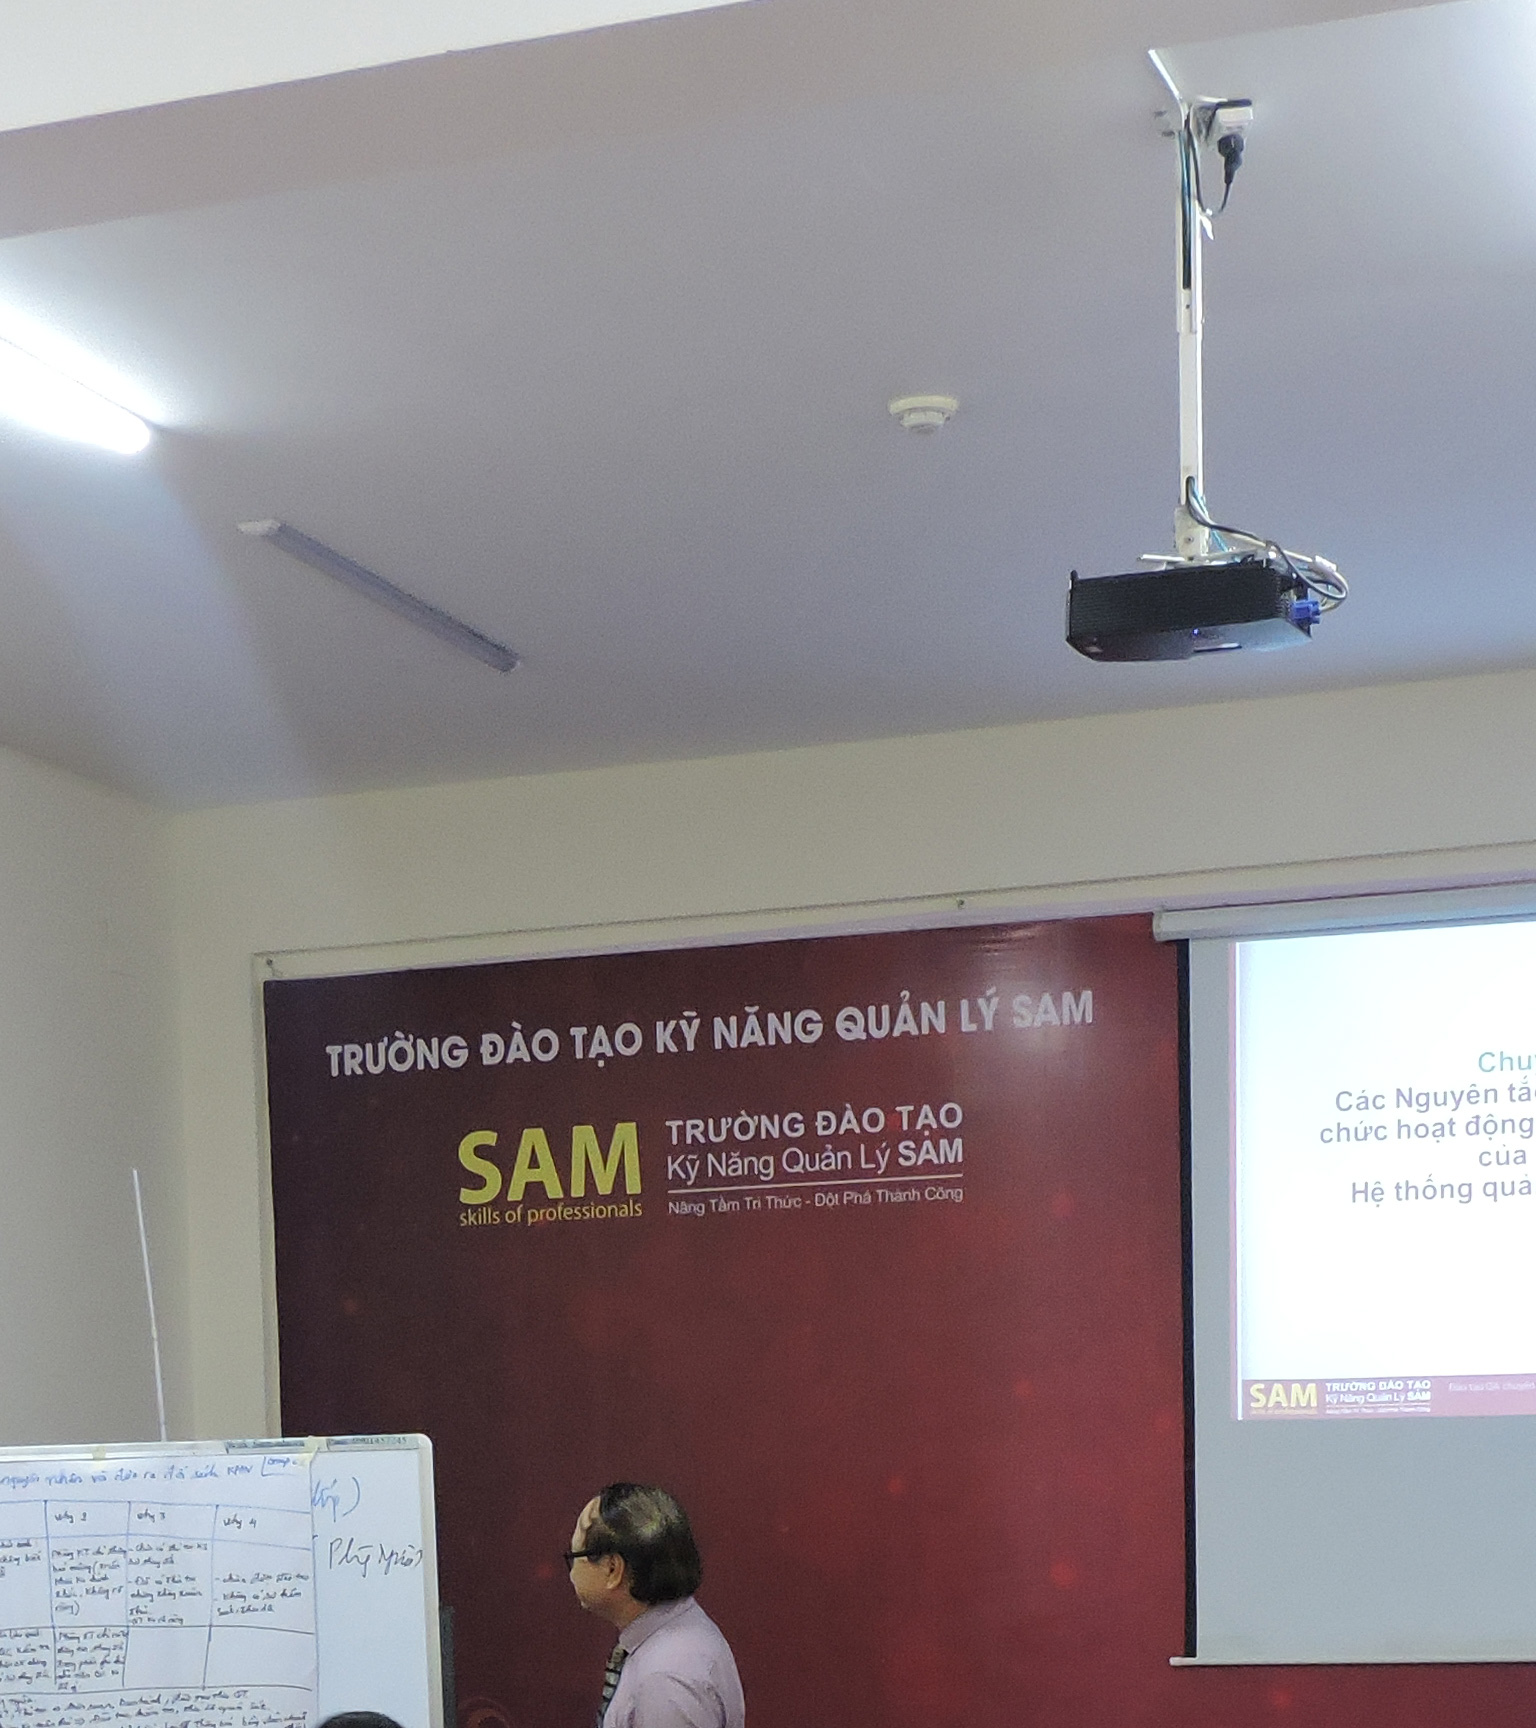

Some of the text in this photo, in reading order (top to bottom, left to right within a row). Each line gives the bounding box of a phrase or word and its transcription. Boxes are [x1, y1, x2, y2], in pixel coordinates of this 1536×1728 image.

[325, 985, 1095, 1077] TRƯỜNG ĐÀO TẠO KỸ NĂNG QUẢN LÝ SAM
[1335, 1088, 1387, 1112] Các
[1395, 1083, 1499, 1114] Nguyên
[665, 1101, 964, 1146] TRƯỜNG ĐÀO TẠO
[1319, 1120, 1389, 1144] chức
[1396, 1117, 1457, 1144] hoạt
[1464, 1113, 1535, 1141] động
[457, 1120, 643, 1206] SAM
[666, 1137, 964, 1187] Kỹ Năng Quản Lý SAM
[1351, 1180, 1386, 1209] Hệ
[1393, 1172, 1474, 1205] thống
[459, 1198, 644, 1227] skills of professionals
[1249, 1382, 1318, 1408] SAM
